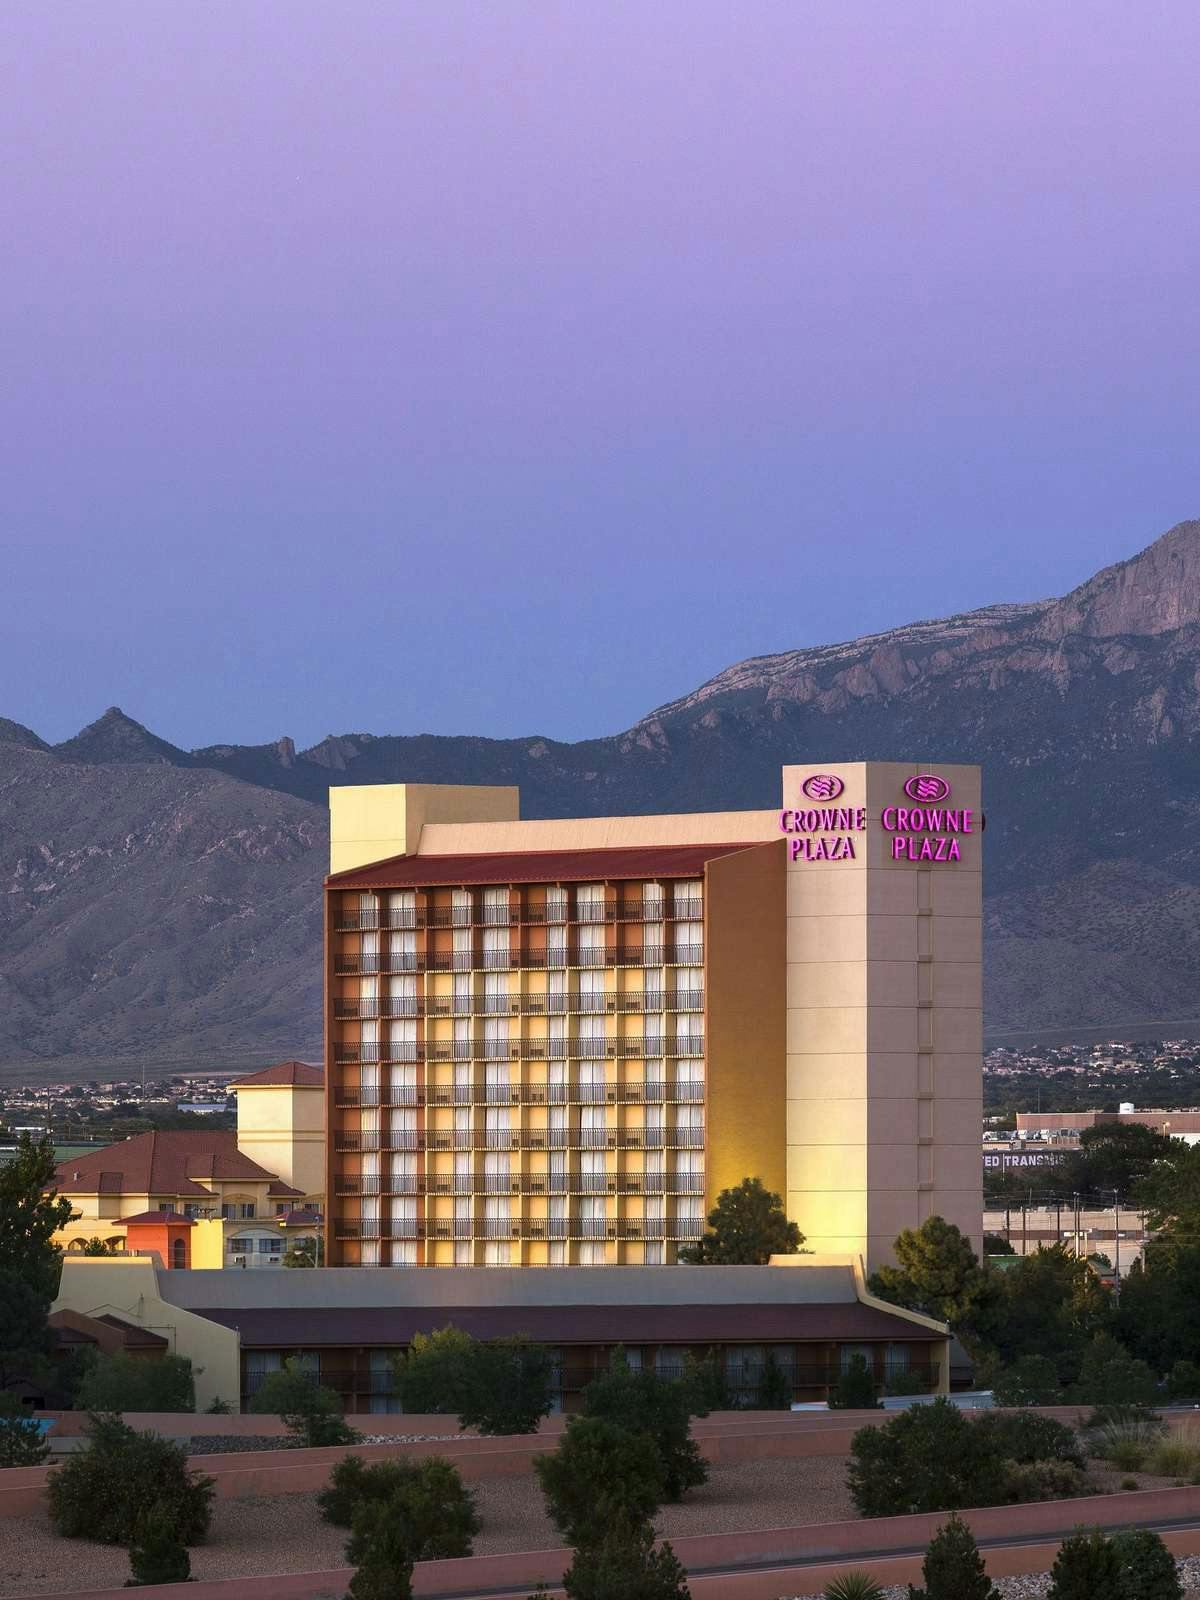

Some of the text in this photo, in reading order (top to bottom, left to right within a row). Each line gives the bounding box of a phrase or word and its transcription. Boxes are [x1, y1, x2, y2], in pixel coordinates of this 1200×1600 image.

[780, 808, 866, 833] CROWNE
[881, 807, 974, 833] CROWNE
[790, 837, 856, 861] PLAZA
[892, 837, 961, 861] PLAZA
[982, 1155, 1000, 1167] ED
